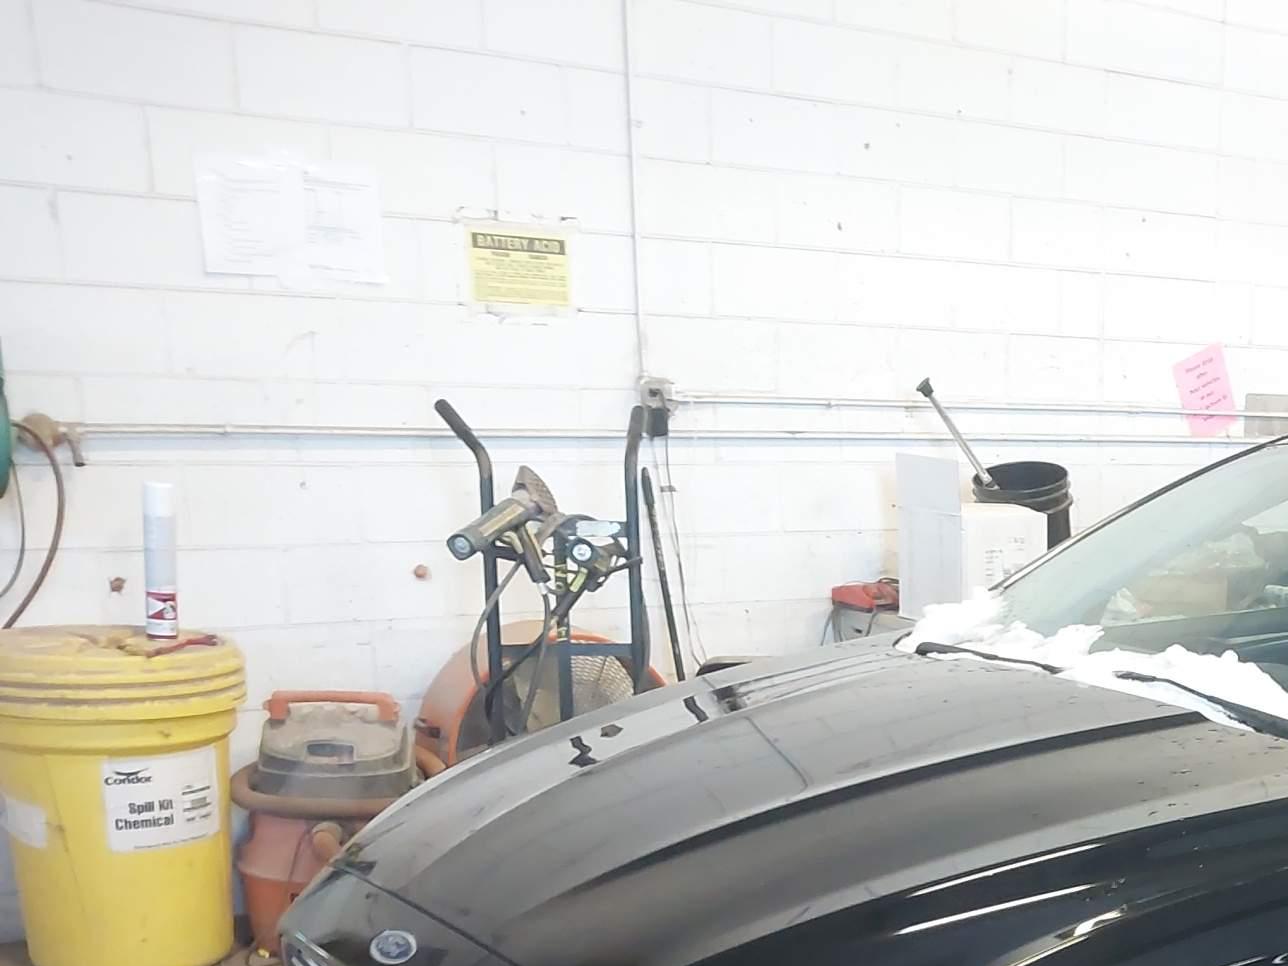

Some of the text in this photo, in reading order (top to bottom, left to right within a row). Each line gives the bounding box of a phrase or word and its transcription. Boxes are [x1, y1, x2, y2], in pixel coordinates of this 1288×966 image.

[476, 233, 561, 255] BATTERY ACID
[104, 775, 152, 786] Condor
[128, 799, 174, 816] Spill Kit
[115, 814, 174, 831] Chemical
